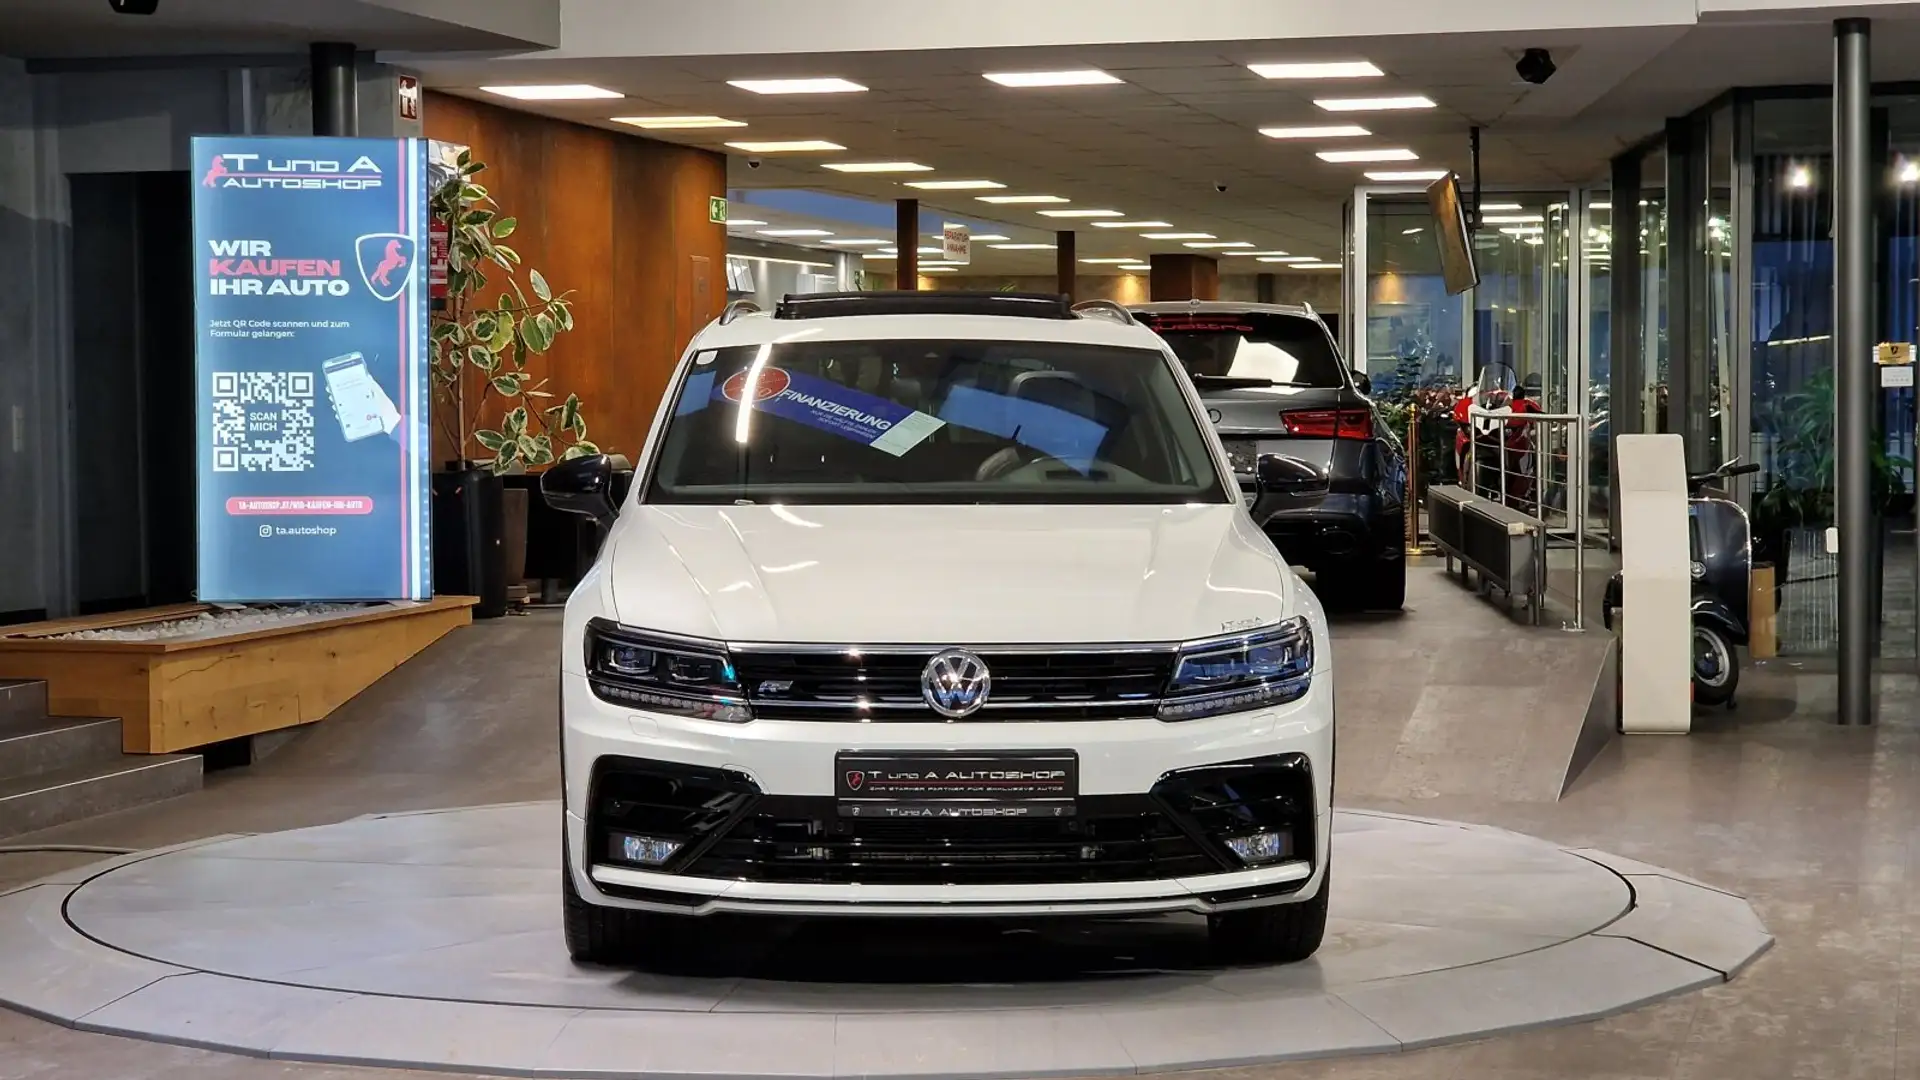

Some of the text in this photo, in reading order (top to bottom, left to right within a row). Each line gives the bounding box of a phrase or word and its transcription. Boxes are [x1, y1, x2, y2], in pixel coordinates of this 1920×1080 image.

[222, 154, 259, 171] T
[347, 156, 382, 172] A
[223, 178, 382, 190] AUTOSHOP
[208, 240, 271, 257] WIR
[209, 260, 340, 276] KAUFEN
[210, 279, 350, 296] IHR AUTO
[210, 320, 231, 328] Jetzt
[232, 320, 247, 329] QR
[248, 320, 271, 328] Code
[311, 320, 328, 328] und
[251, 330, 294, 339] gelangen:
[780, 389, 892, 430] FINANZIERUNG
[250, 412, 277, 421] SCAN
[250, 422, 277, 431] MICH
[275, 525, 337, 536] ta.autoshop
[867, 771, 882, 779] T
[925, 771, 939, 779] A
[945, 771, 1065, 779] AUTOSHOP
[886, 808, 898, 816] T
[922, 808, 932, 816] A
[939, 808, 1027, 816] AUTOSHOP
